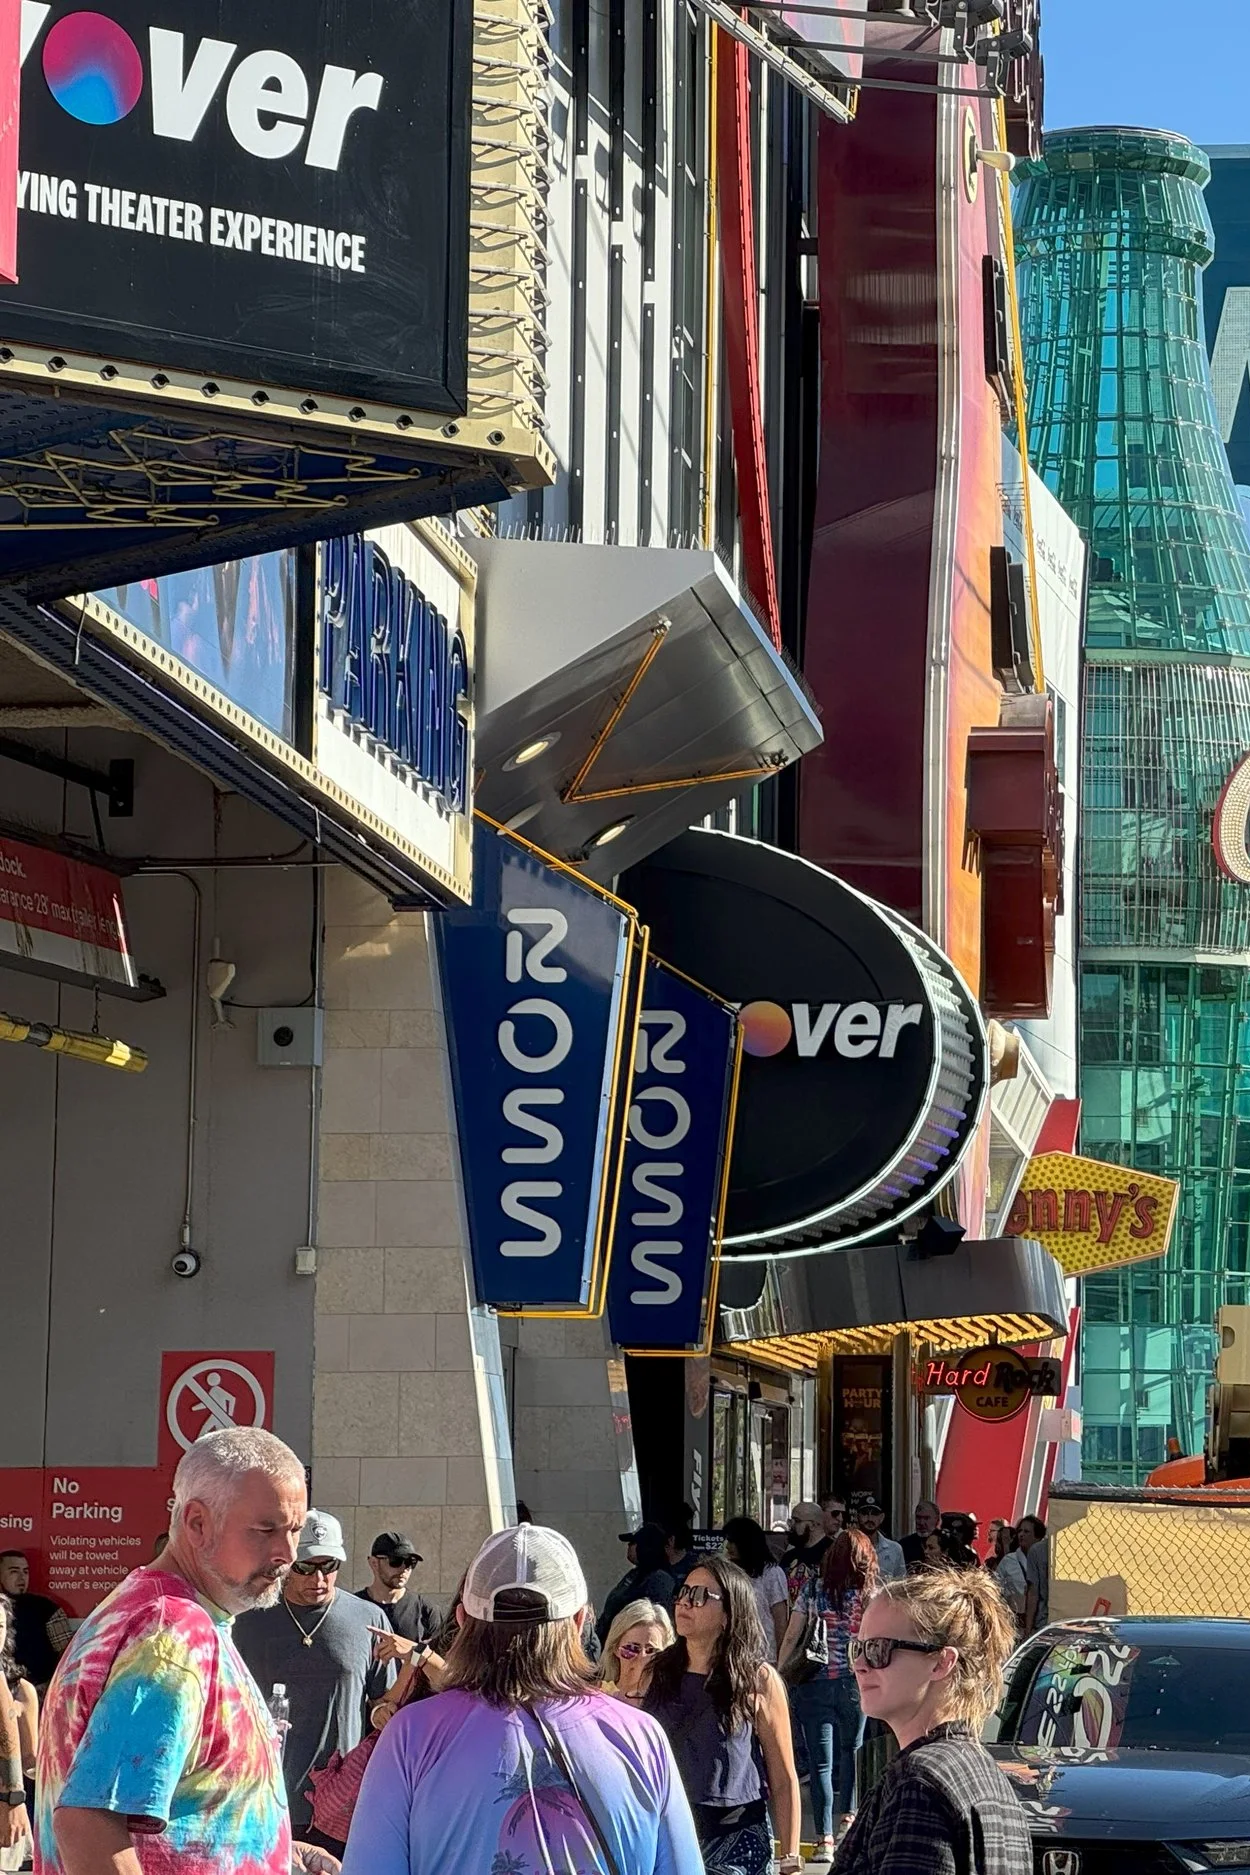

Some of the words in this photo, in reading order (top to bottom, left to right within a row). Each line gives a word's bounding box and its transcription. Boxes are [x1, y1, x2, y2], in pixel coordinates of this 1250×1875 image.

[84, 183, 203, 243] THEATER
[210, 207, 366, 273] EXPERIENCE
[51, 902, 72, 922] max
[497, 907, 574, 1258] ROSS
[628, 1009, 691, 1306] ROSS
[926, 1360, 991, 1386] Hard
[993, 1361, 1056, 1393] Rock
[842, 1388, 881, 1398] PARTY
[976, 1396, 1009, 1407] CAFE
[53, 1477, 80, 1494] No
[52, 1502, 122, 1523] Parking
[0, 1514, 33, 1531] sing
[50, 1536, 96, 1547] Violating
[98, 1536, 141, 1546] vehicles
[692, 1534, 724, 1542] Tickets
[49, 1550, 67, 1560] will
[70, 1550, 83, 1560] be
[85, 1550, 118, 1560] towed
[49, 1567, 76, 1578] away
[79, 1565, 89, 1575] at
[91, 1565, 129, 1575] vehicle
[48, 1579, 90, 1589] owner's
[92, 1581, 118, 1592] expe
